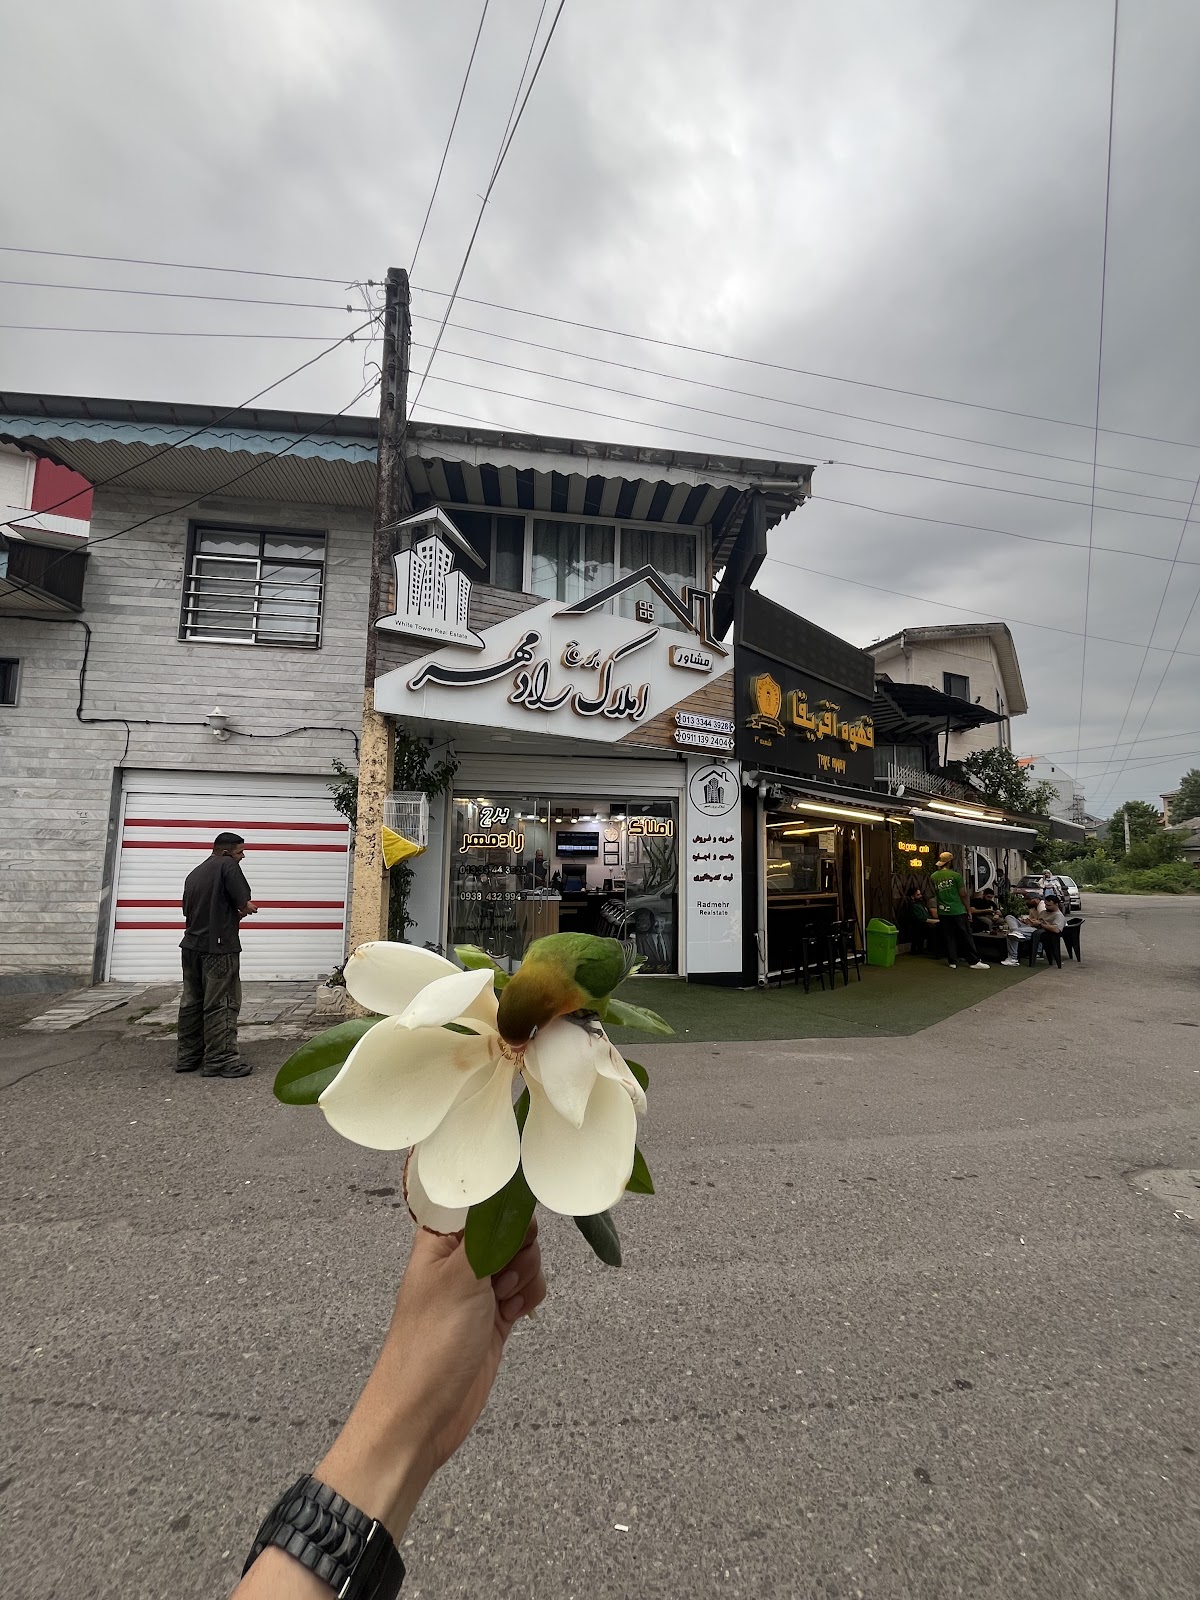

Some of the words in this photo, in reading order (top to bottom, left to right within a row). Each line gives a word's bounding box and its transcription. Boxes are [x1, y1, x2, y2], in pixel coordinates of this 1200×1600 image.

[395, 620, 413, 628] White
[415, 624, 433, 632] Tower
[449, 631, 468, 639] Estate
[563, 640, 602, 669] برج
[677, 653, 710, 667] مشاور
[574, 627, 660, 721] املاک
[682, 715, 695, 724] 013
[696, 718, 712, 727] 3344
[713, 720, 729, 730] 3928
[790, 690, 840, 741] آفریقا
[682, 732, 696, 742] 0911
[698, 734, 709, 744] 139
[711, 736, 728, 746] 2404
[841, 715, 874, 752] قهوه
[817, 753, 831, 770] TAKE
[832, 757, 846, 774] AWAY
[480, 807, 510, 827] برج
[627, 819, 674, 837] املاک
[460, 892, 482, 901] 0938
[486, 892, 502, 901] 432
